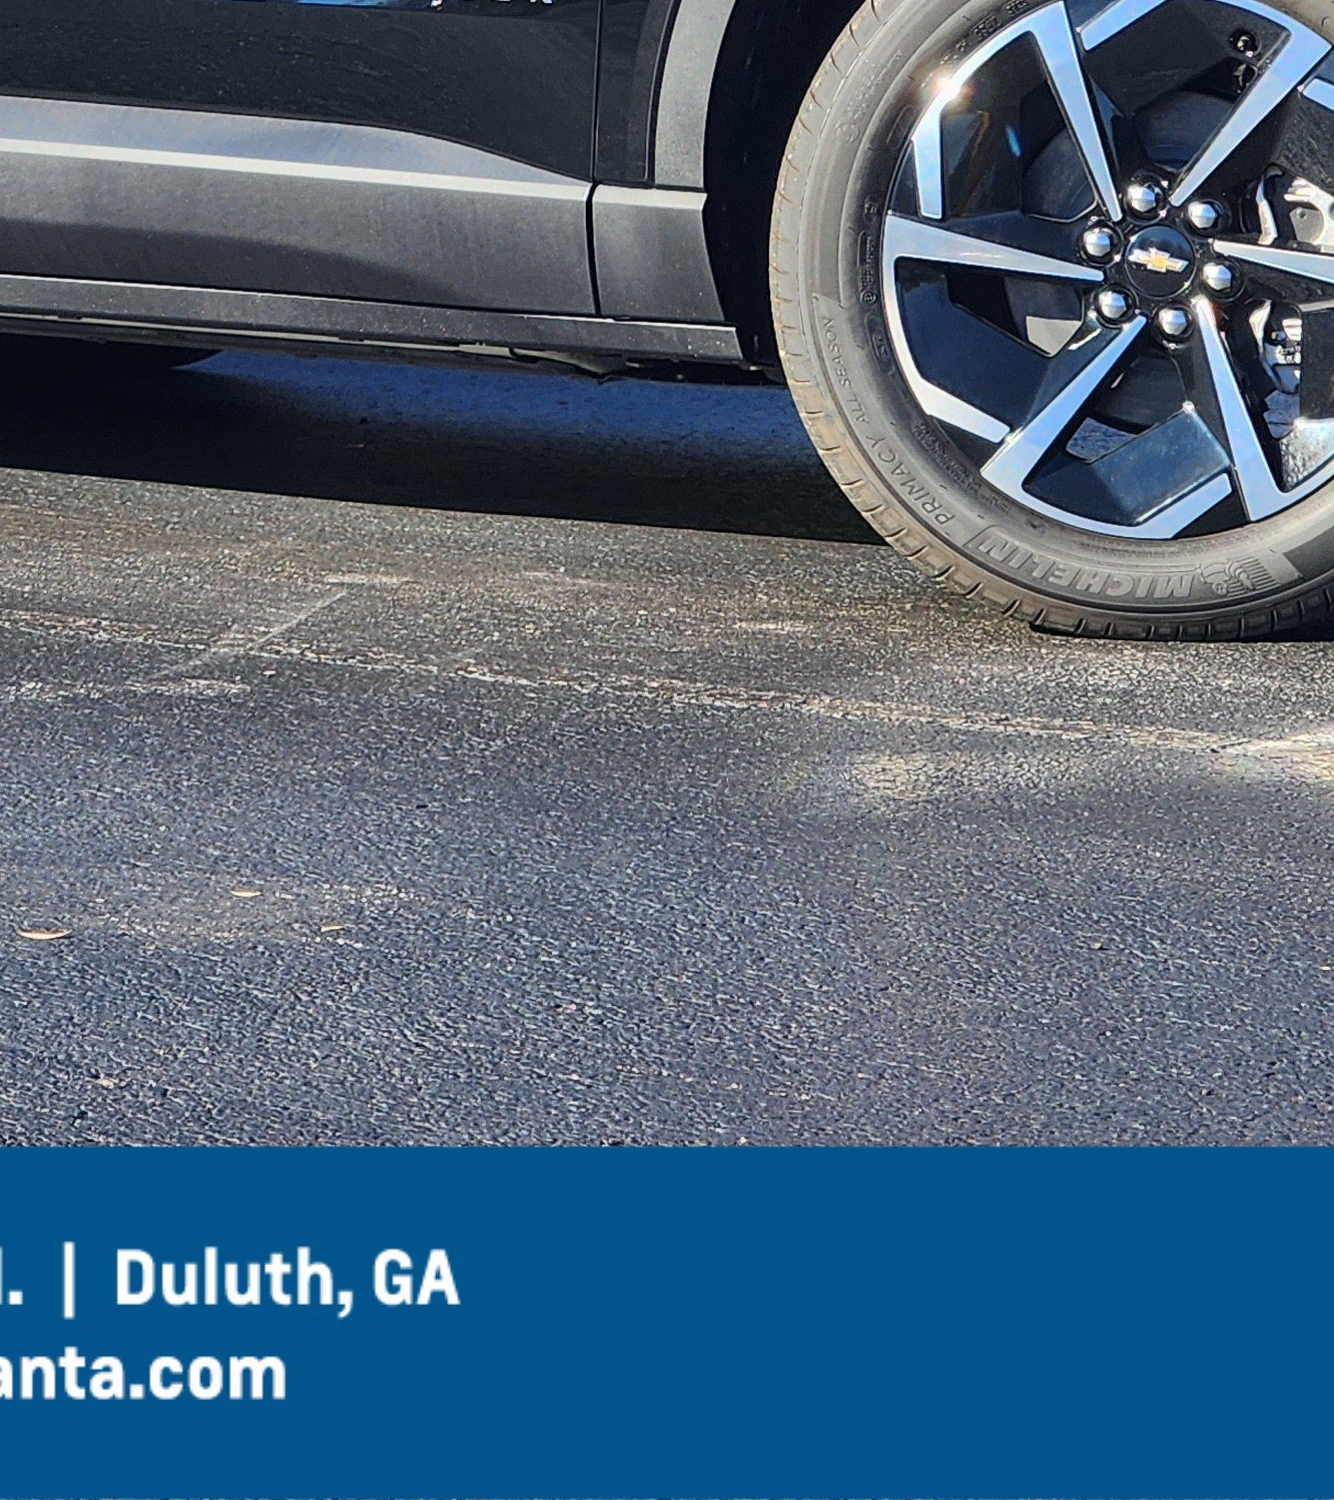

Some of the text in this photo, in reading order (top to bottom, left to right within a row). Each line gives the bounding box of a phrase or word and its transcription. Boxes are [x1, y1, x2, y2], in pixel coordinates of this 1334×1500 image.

[821, 316, 955, 525] PRIMACY ALL SEASON
[978, 537, 1195, 599] MICHELIN
